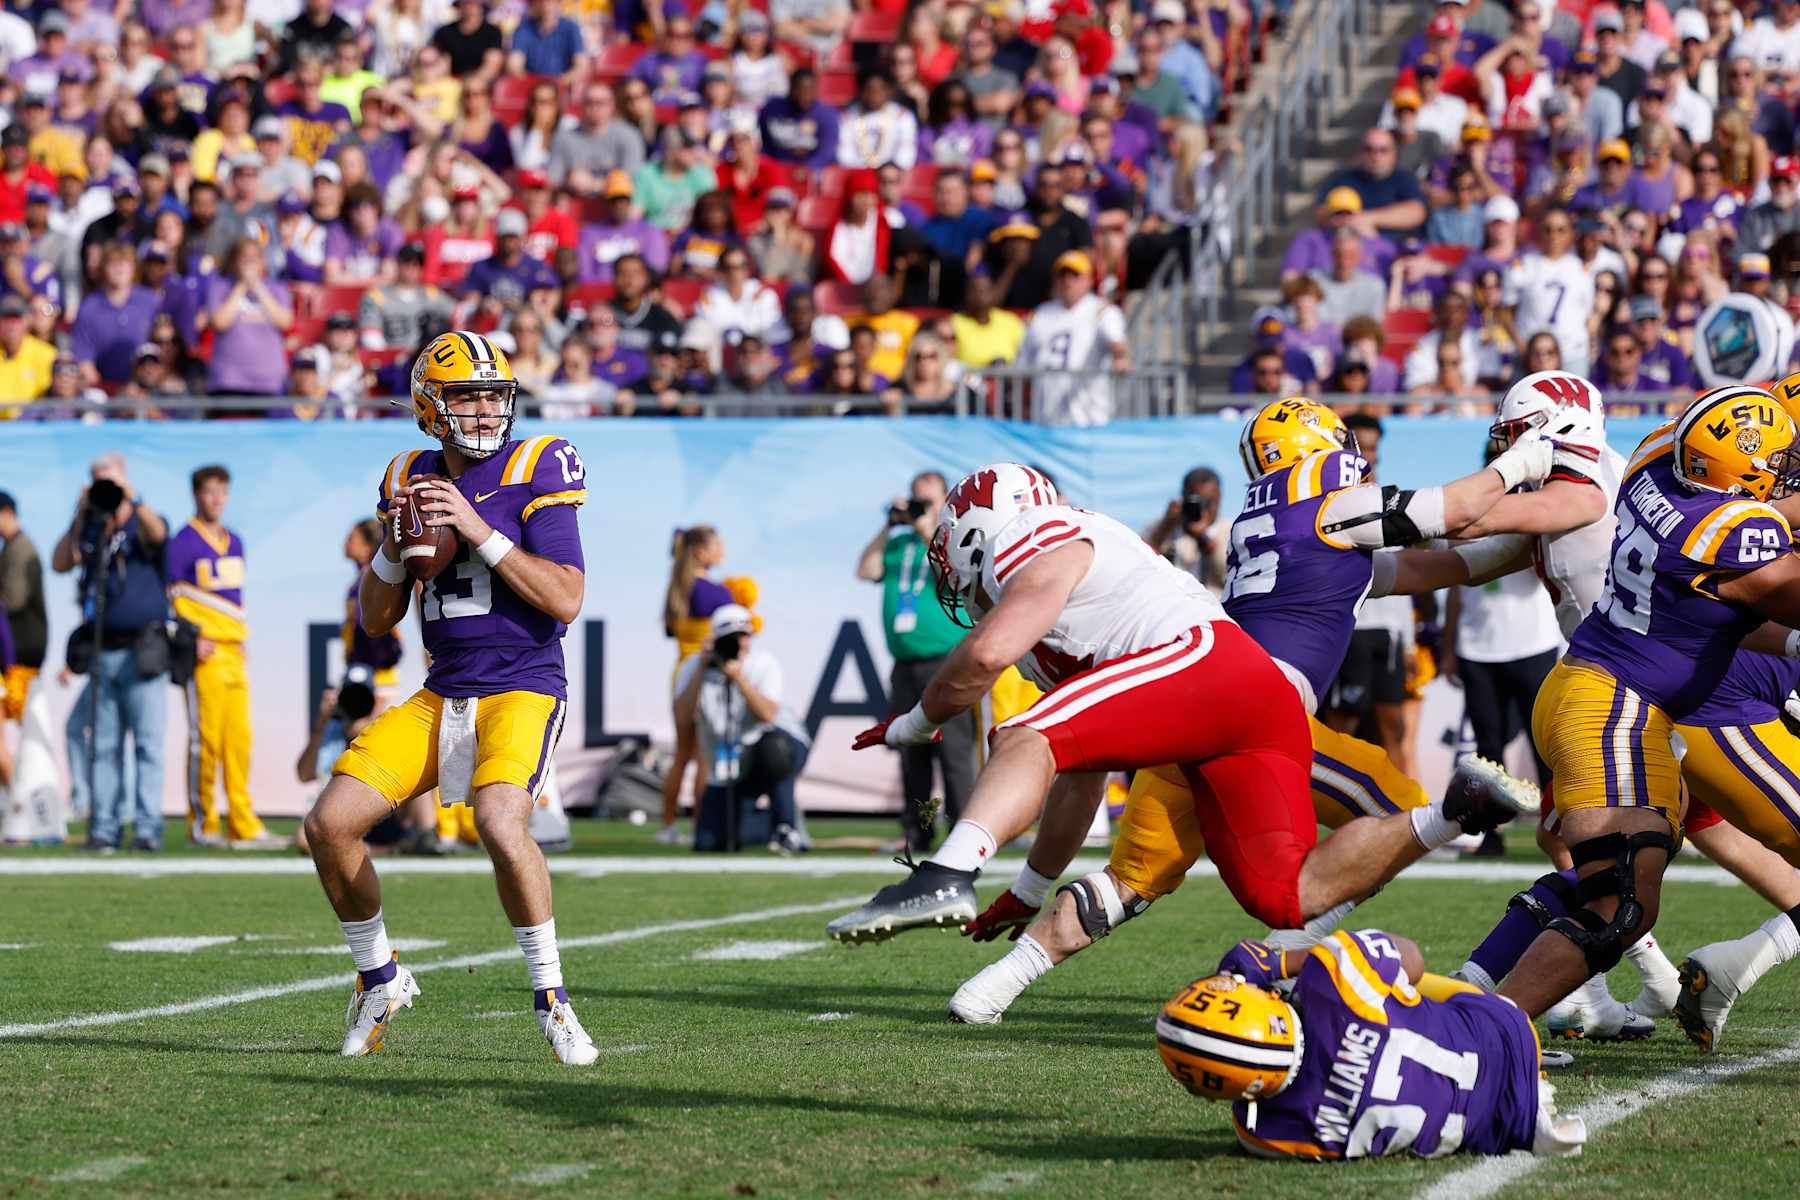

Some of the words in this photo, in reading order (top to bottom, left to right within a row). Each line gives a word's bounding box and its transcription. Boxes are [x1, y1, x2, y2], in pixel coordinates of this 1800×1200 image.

[1544, 281, 1566, 325] 7
[479, 371, 497, 379] LSU
[1531, 376, 1591, 413] W
[1705, 403, 1775, 442] LSU
[554, 444, 585, 484] 13
[944, 468, 998, 519] W
[1628, 470, 1675, 529] TURNER
[1737, 527, 1780, 563] 69
[1313, 1021, 1382, 1144] WILLIAMS
